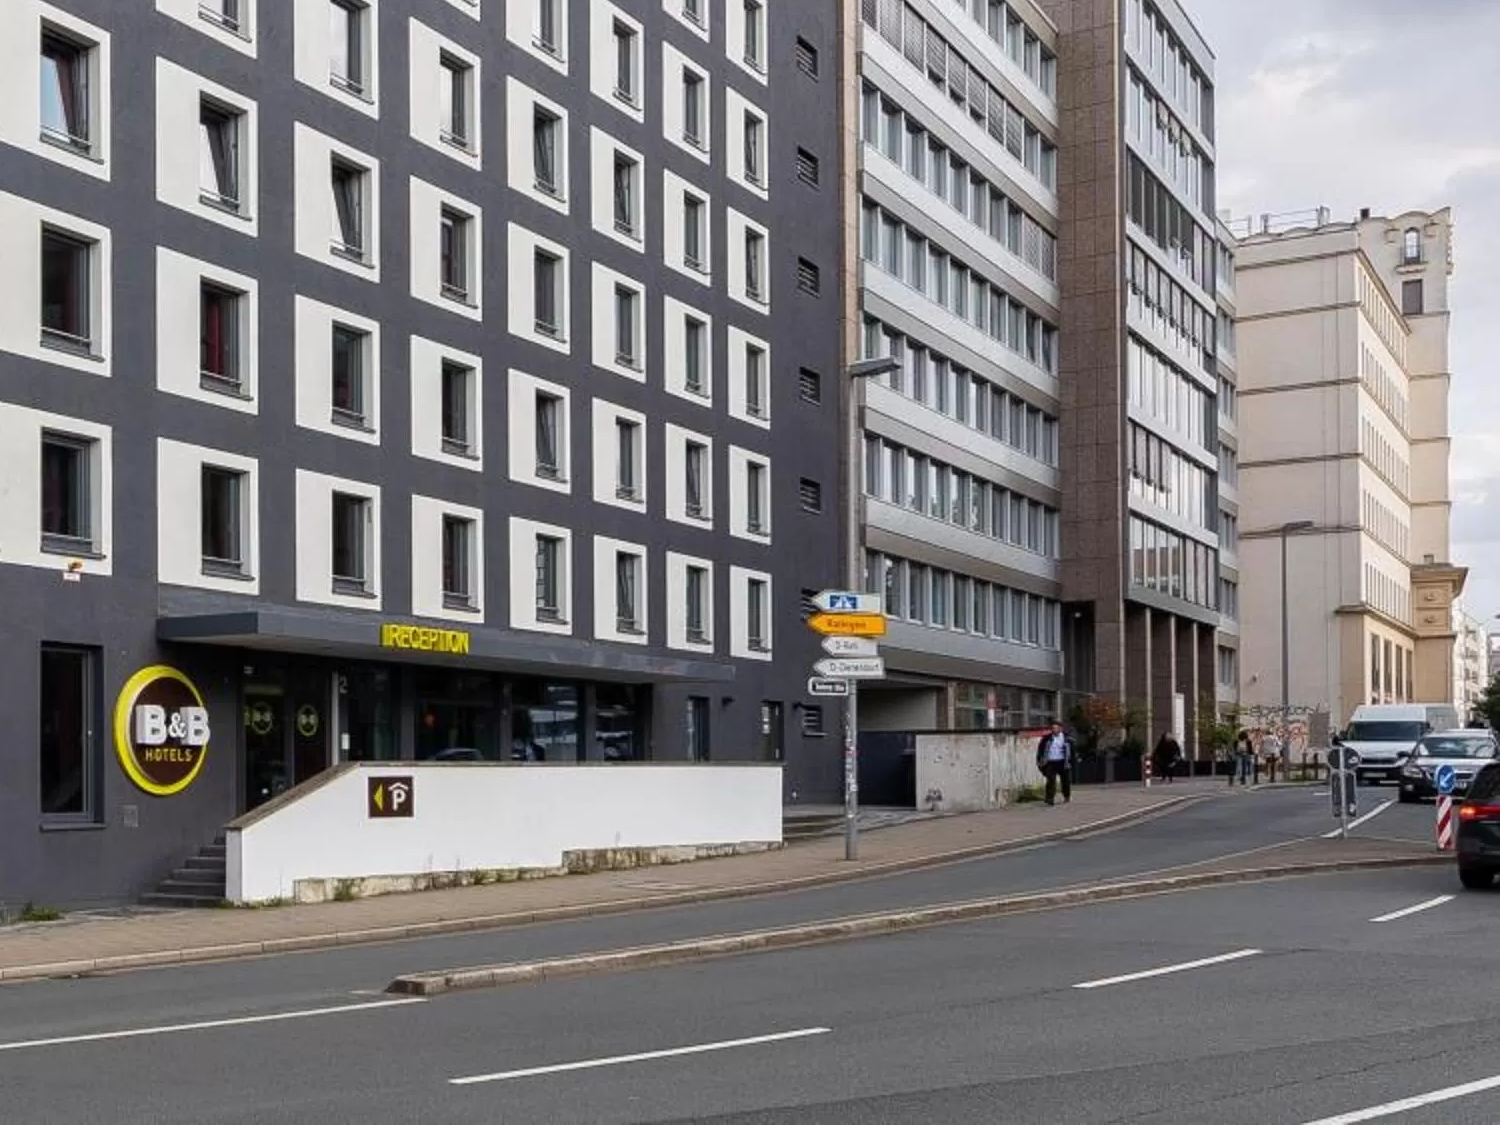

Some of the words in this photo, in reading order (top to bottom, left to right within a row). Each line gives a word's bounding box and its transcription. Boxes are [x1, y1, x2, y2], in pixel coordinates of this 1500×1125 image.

[382, 624, 469, 654] RECEPTION
[135, 704, 211, 746] B&B
[145, 748, 193, 762] HOTELS
